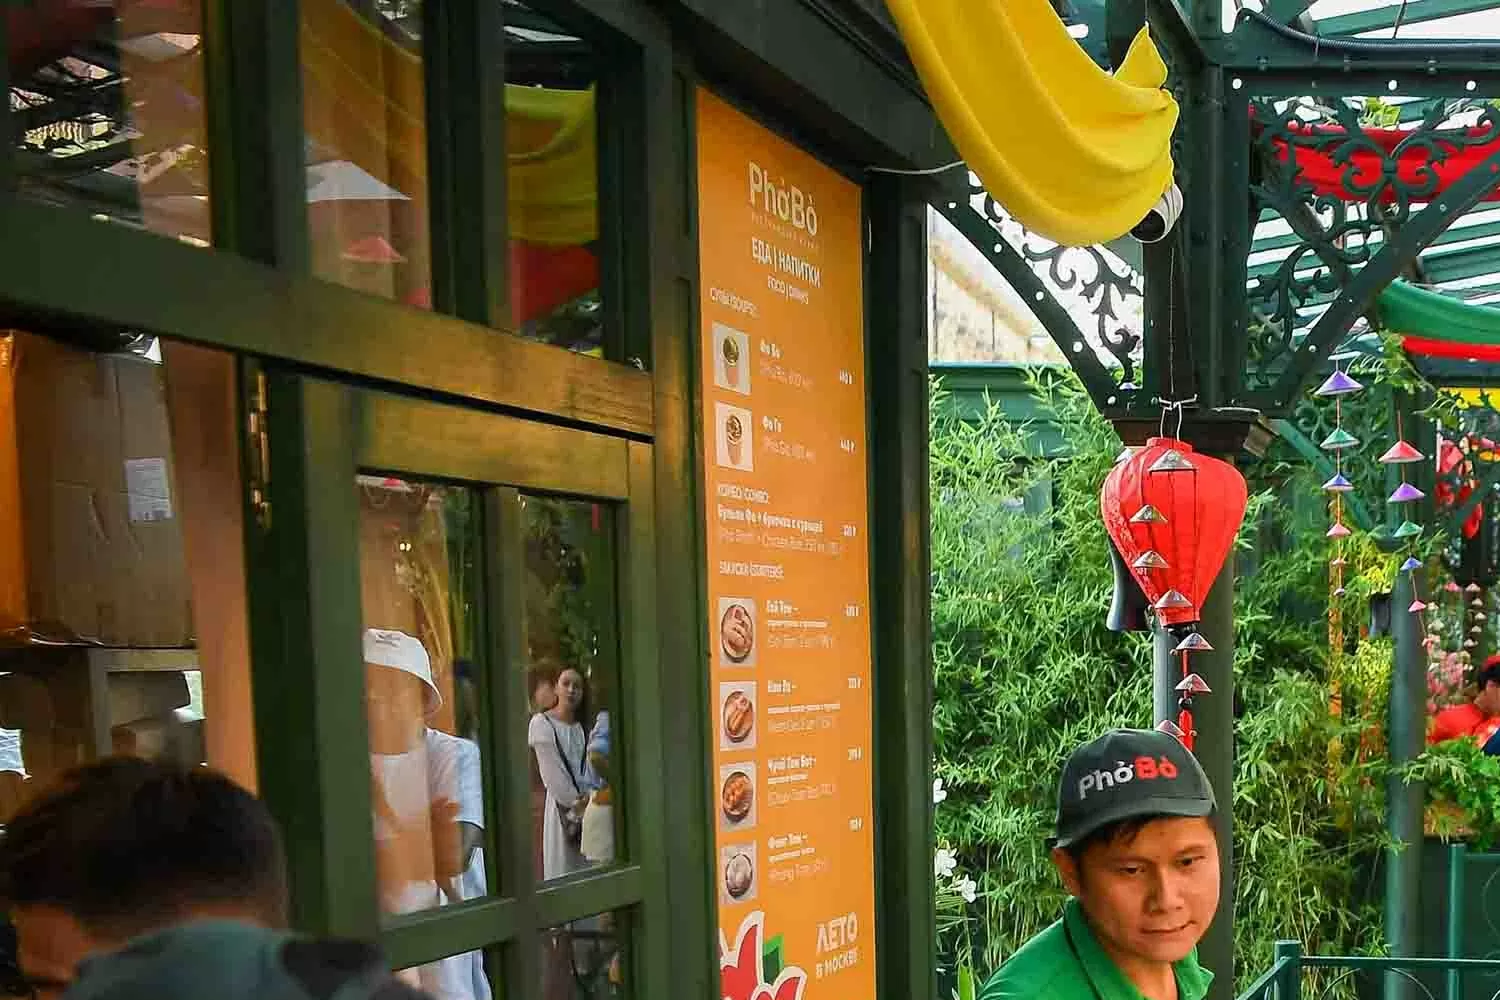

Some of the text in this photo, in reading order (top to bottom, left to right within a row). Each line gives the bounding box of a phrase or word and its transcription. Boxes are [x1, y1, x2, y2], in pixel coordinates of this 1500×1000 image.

[751, 236, 822, 289] ЕДА НАПИТКИ
[1078, 754, 1180, 801] PhởBò
